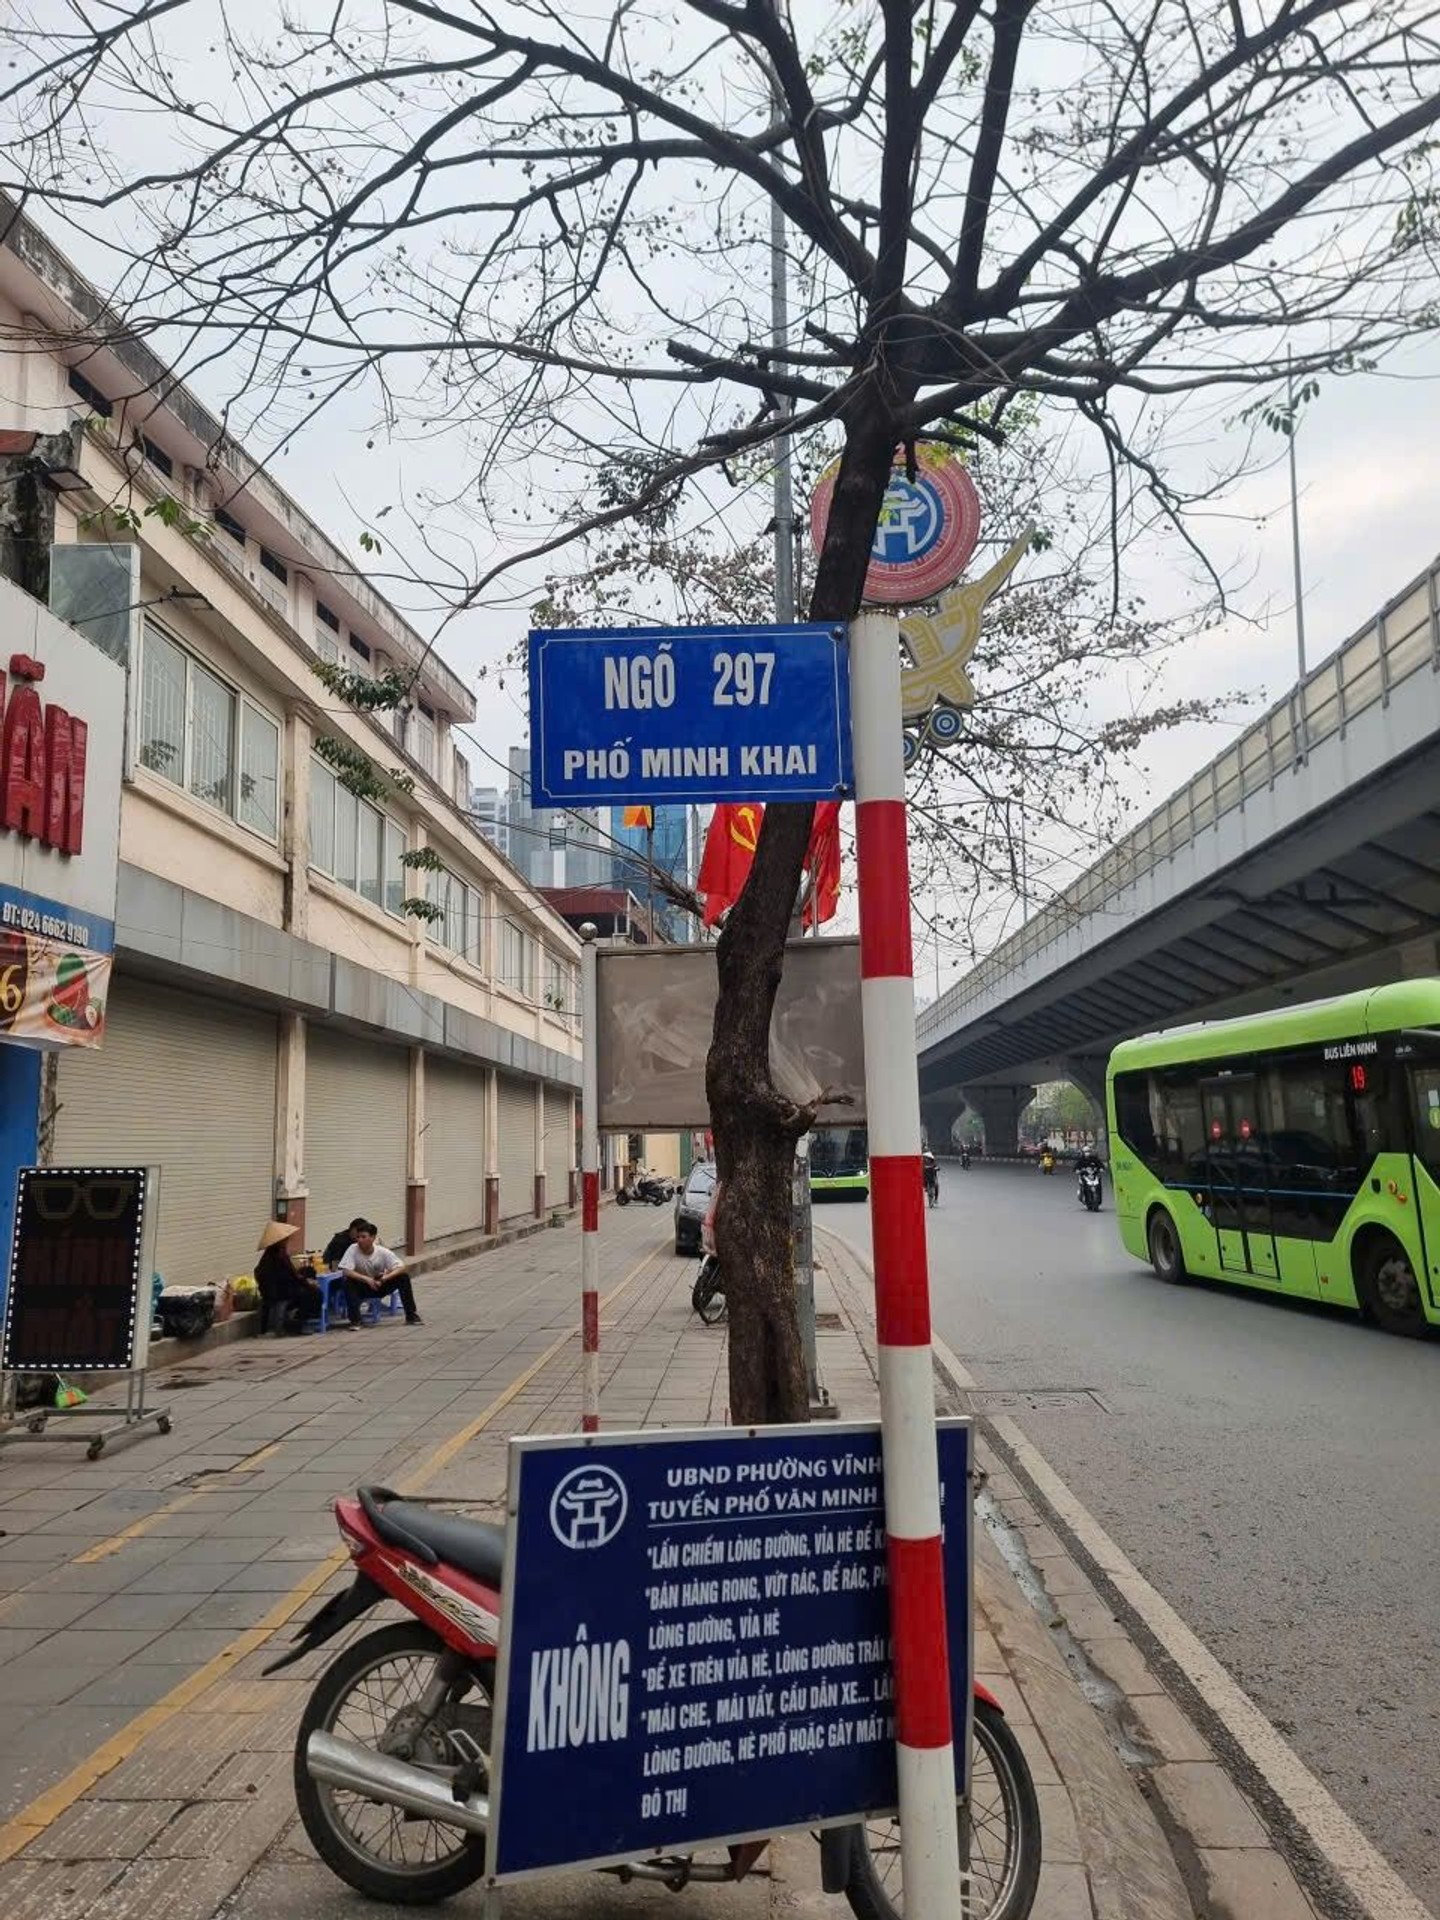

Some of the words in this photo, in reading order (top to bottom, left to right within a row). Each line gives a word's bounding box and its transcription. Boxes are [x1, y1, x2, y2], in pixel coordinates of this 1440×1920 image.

[603, 641, 675, 710] NGÕ
[713, 652, 775, 706] 297
[563, 736, 632, 780] PHỐ
[641, 746, 729, 779] MINH
[740, 744, 817, 776] KHAI
[1352, 1065, 1365, 1089] 19
[667, 1466, 731, 1488] UBND
[736, 1456, 828, 1483] PHƯỜNG
[832, 1453, 882, 1476] VĨNH
[648, 1490, 719, 1520] TUYẾN
[725, 1486, 770, 1514] PHỐ
[774, 1488, 817, 1511] VĂN
[822, 1487, 877, 1507] MINH
[682, 1534, 724, 1567] CHIẾM
[727, 1533, 761, 1562] LÒNG
[764, 1530, 811, 1559] ĐƯỜNG,
[682, 1578, 719, 1607] HÀNG
[722, 1577, 761, 1603] RONG,
[765, 1570, 788, 1598] VỨT
[791, 1566, 820, 1596] RÁC,
[842, 1562, 870, 1590] RÁC,
[648, 1620, 684, 1650] LÒNG
[687, 1614, 736, 1646] ĐƯỜNG,
[668, 1663, 686, 1689] XE
[690, 1655, 724, 1686] TRÊN
[776, 1644, 809, 1674] LÒNG
[811, 1639, 855, 1670] ĐƯỜNG
[857, 1634, 885, 1664] TRÁI
[526, 1623, 630, 1753] KHÔNG
[679, 1702, 711, 1730] CHE,
[717, 1692, 744, 1724] MÁI
[841, 1681, 870, 1706] XE...
[643, 1745, 680, 1777] LÒNG
[684, 1737, 735, 1770] ĐƯỜNG,
[738, 1731, 756, 1761] HÈ
[759, 1721, 787, 1758] PHỐ
[790, 1722, 825, 1756] HOẶC
[828, 1717, 853, 1748] GÂY
[856, 1710, 884, 1743] MẤT
[641, 1787, 661, 1819] ĐÔ
[665, 1788, 688, 1818] THỊ
